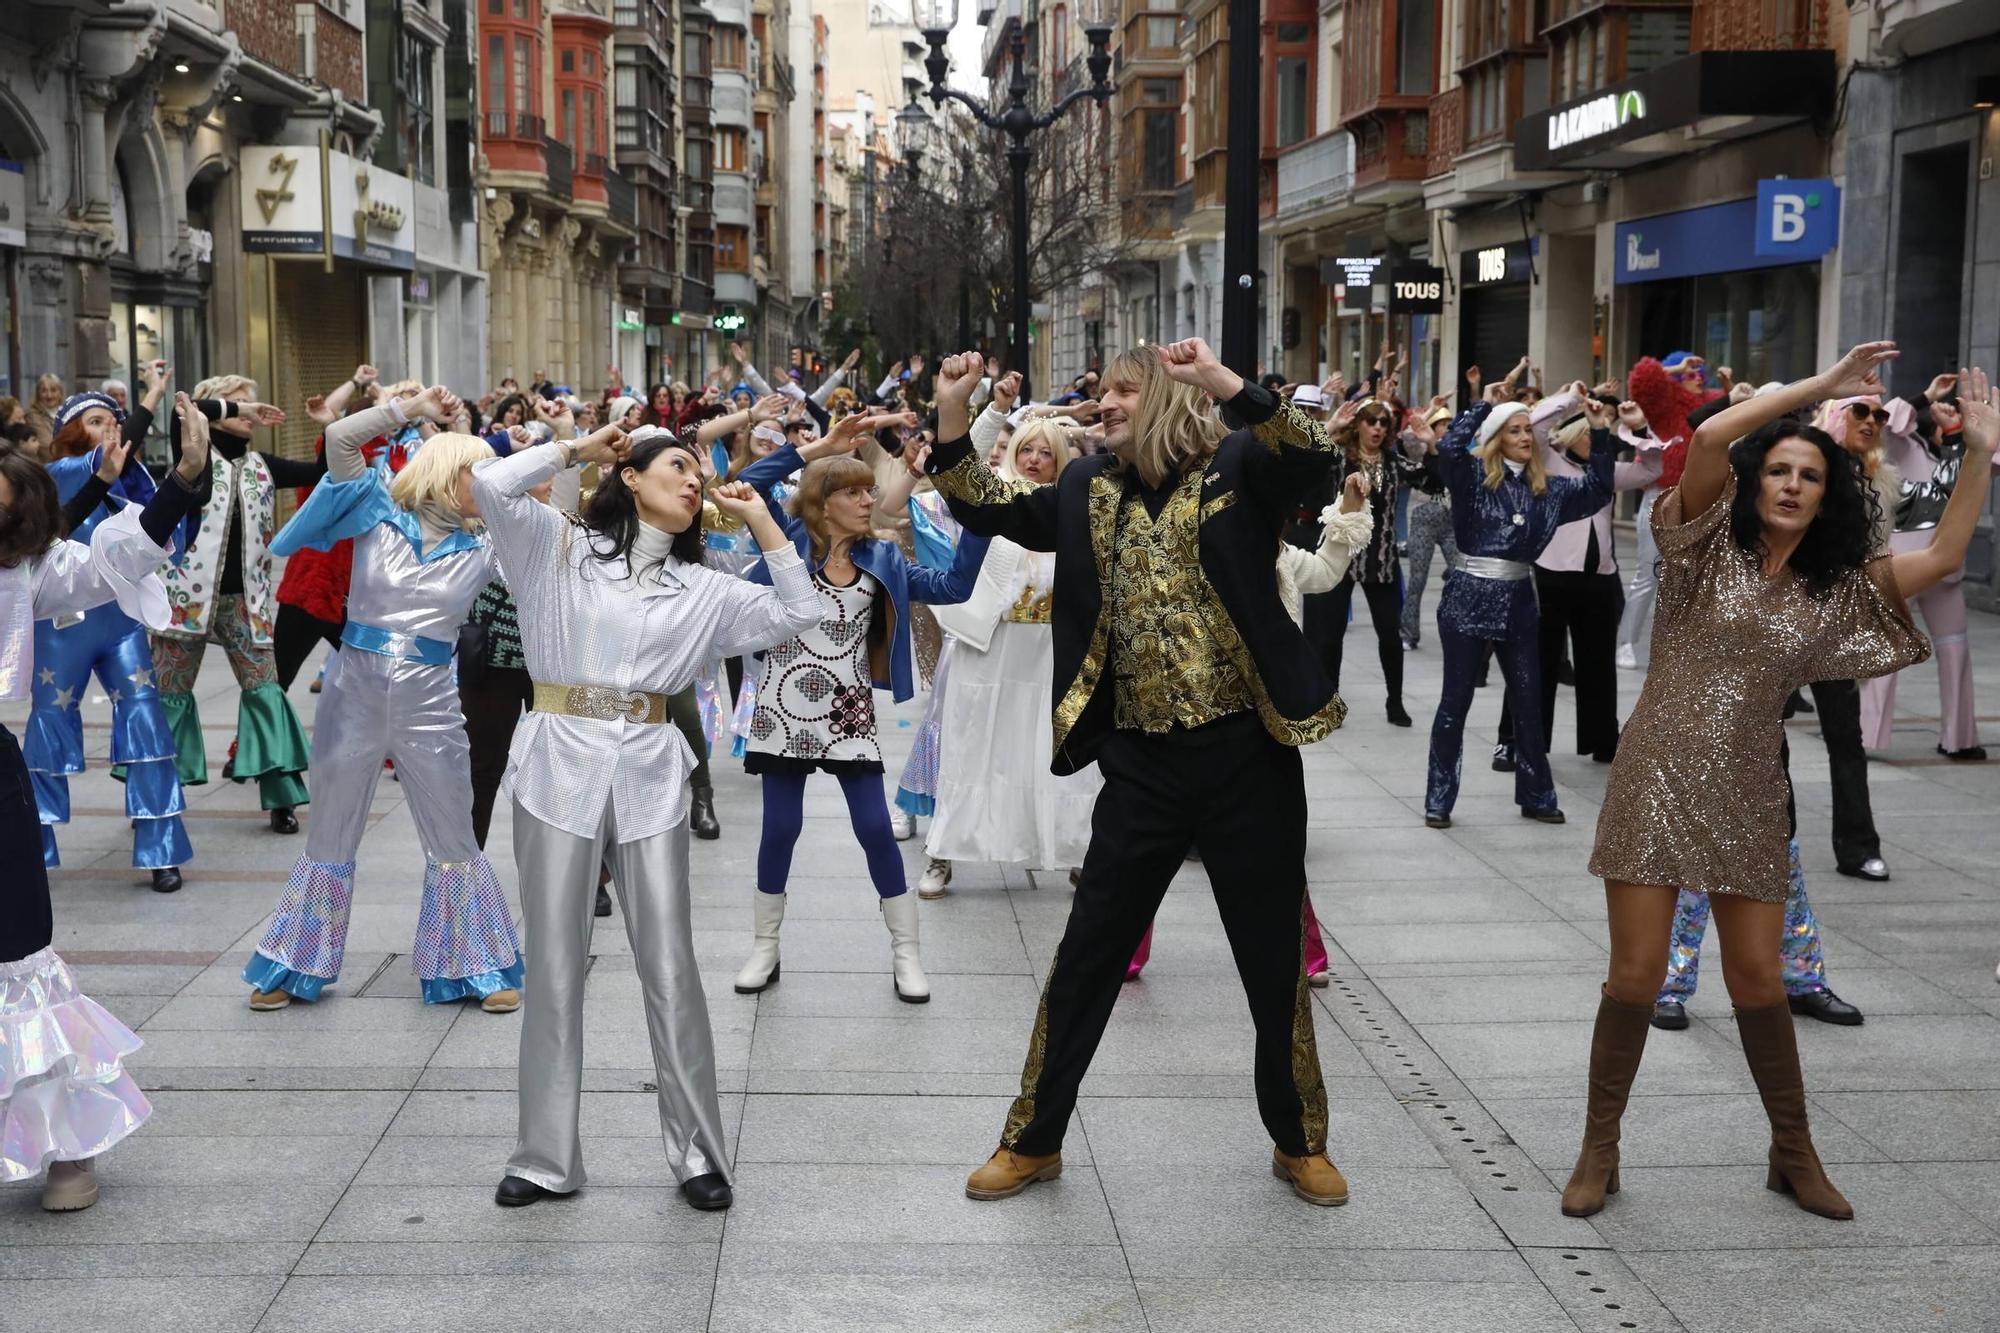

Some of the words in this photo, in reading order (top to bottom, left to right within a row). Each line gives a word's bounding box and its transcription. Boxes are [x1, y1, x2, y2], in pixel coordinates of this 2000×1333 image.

[1772, 194, 1806, 243] B
[1478, 247, 1506, 282] TOUS
[1394, 282, 1441, 300] TOUS
